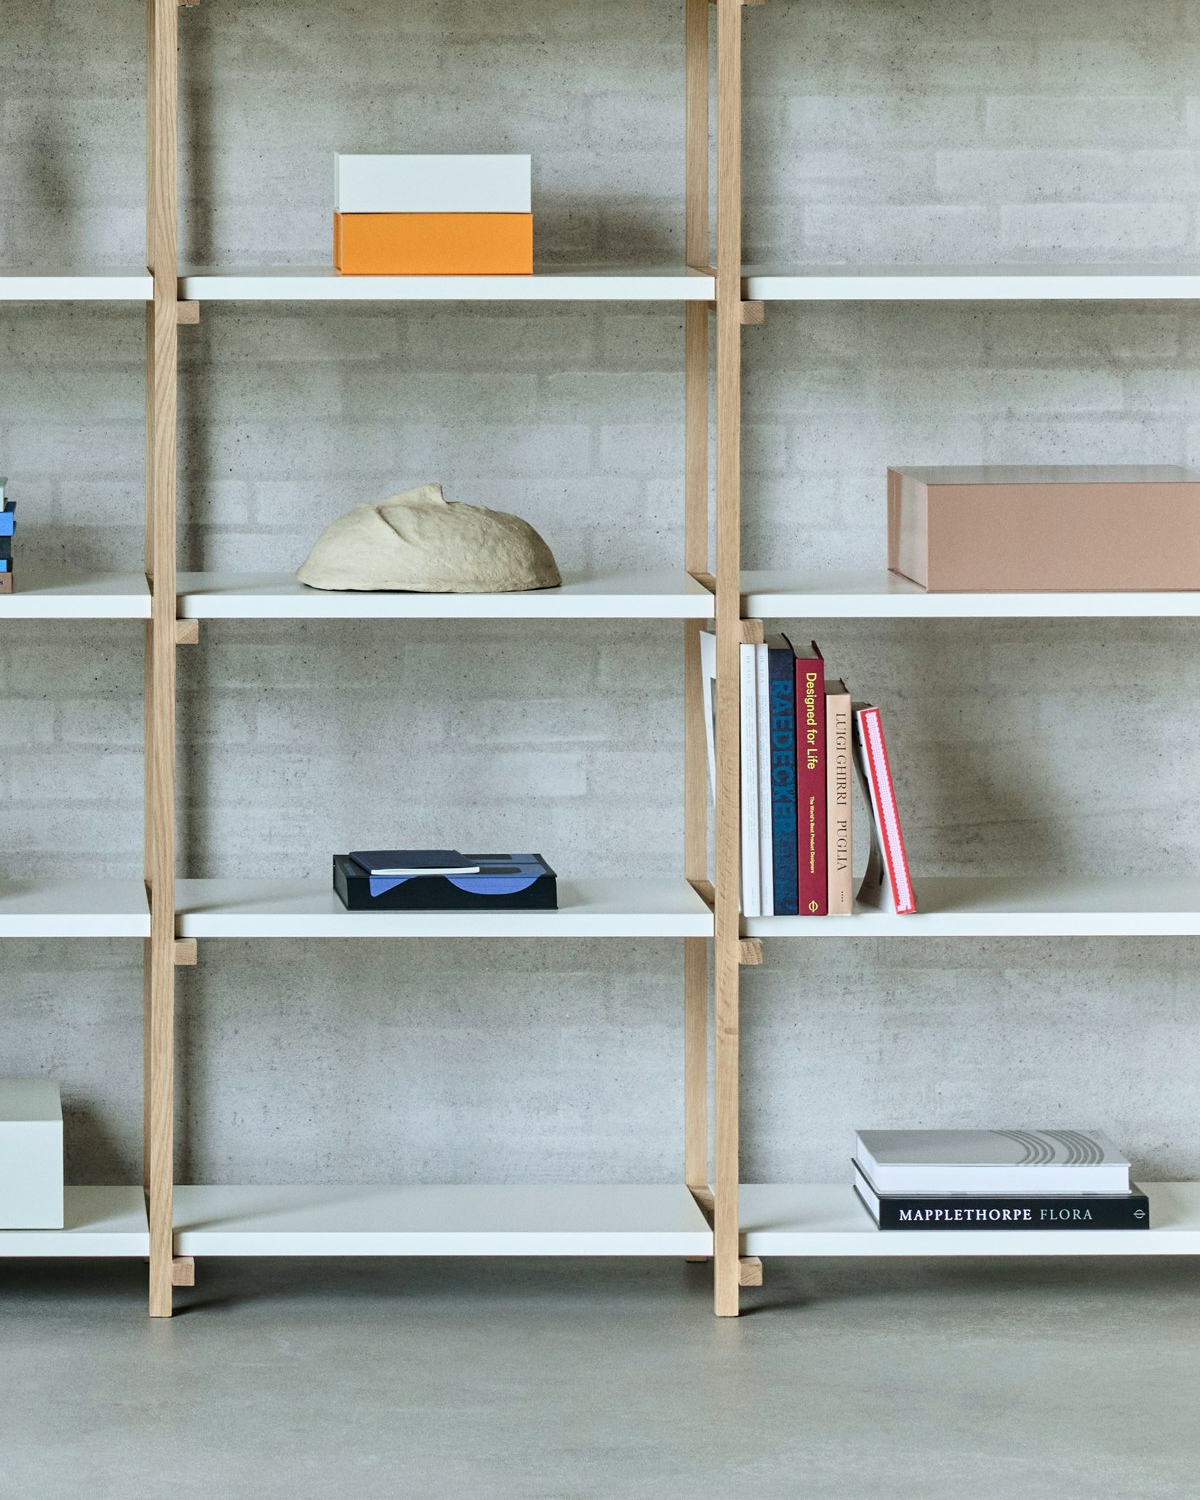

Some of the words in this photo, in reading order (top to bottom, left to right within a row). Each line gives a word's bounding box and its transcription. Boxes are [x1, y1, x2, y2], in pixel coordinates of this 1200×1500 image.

[805, 672, 817, 726] Designed
[807, 729, 818, 745] for
[836, 713, 846, 751] LUIGI
[807, 749, 818, 770] Life
[836, 755, 847, 805] GHIRRI
[837, 820, 847, 871] PUGLIA
[899, 1209, 1032, 1221] MAPPLETHORPE
[1040, 1209, 1093, 1221] FLORA
